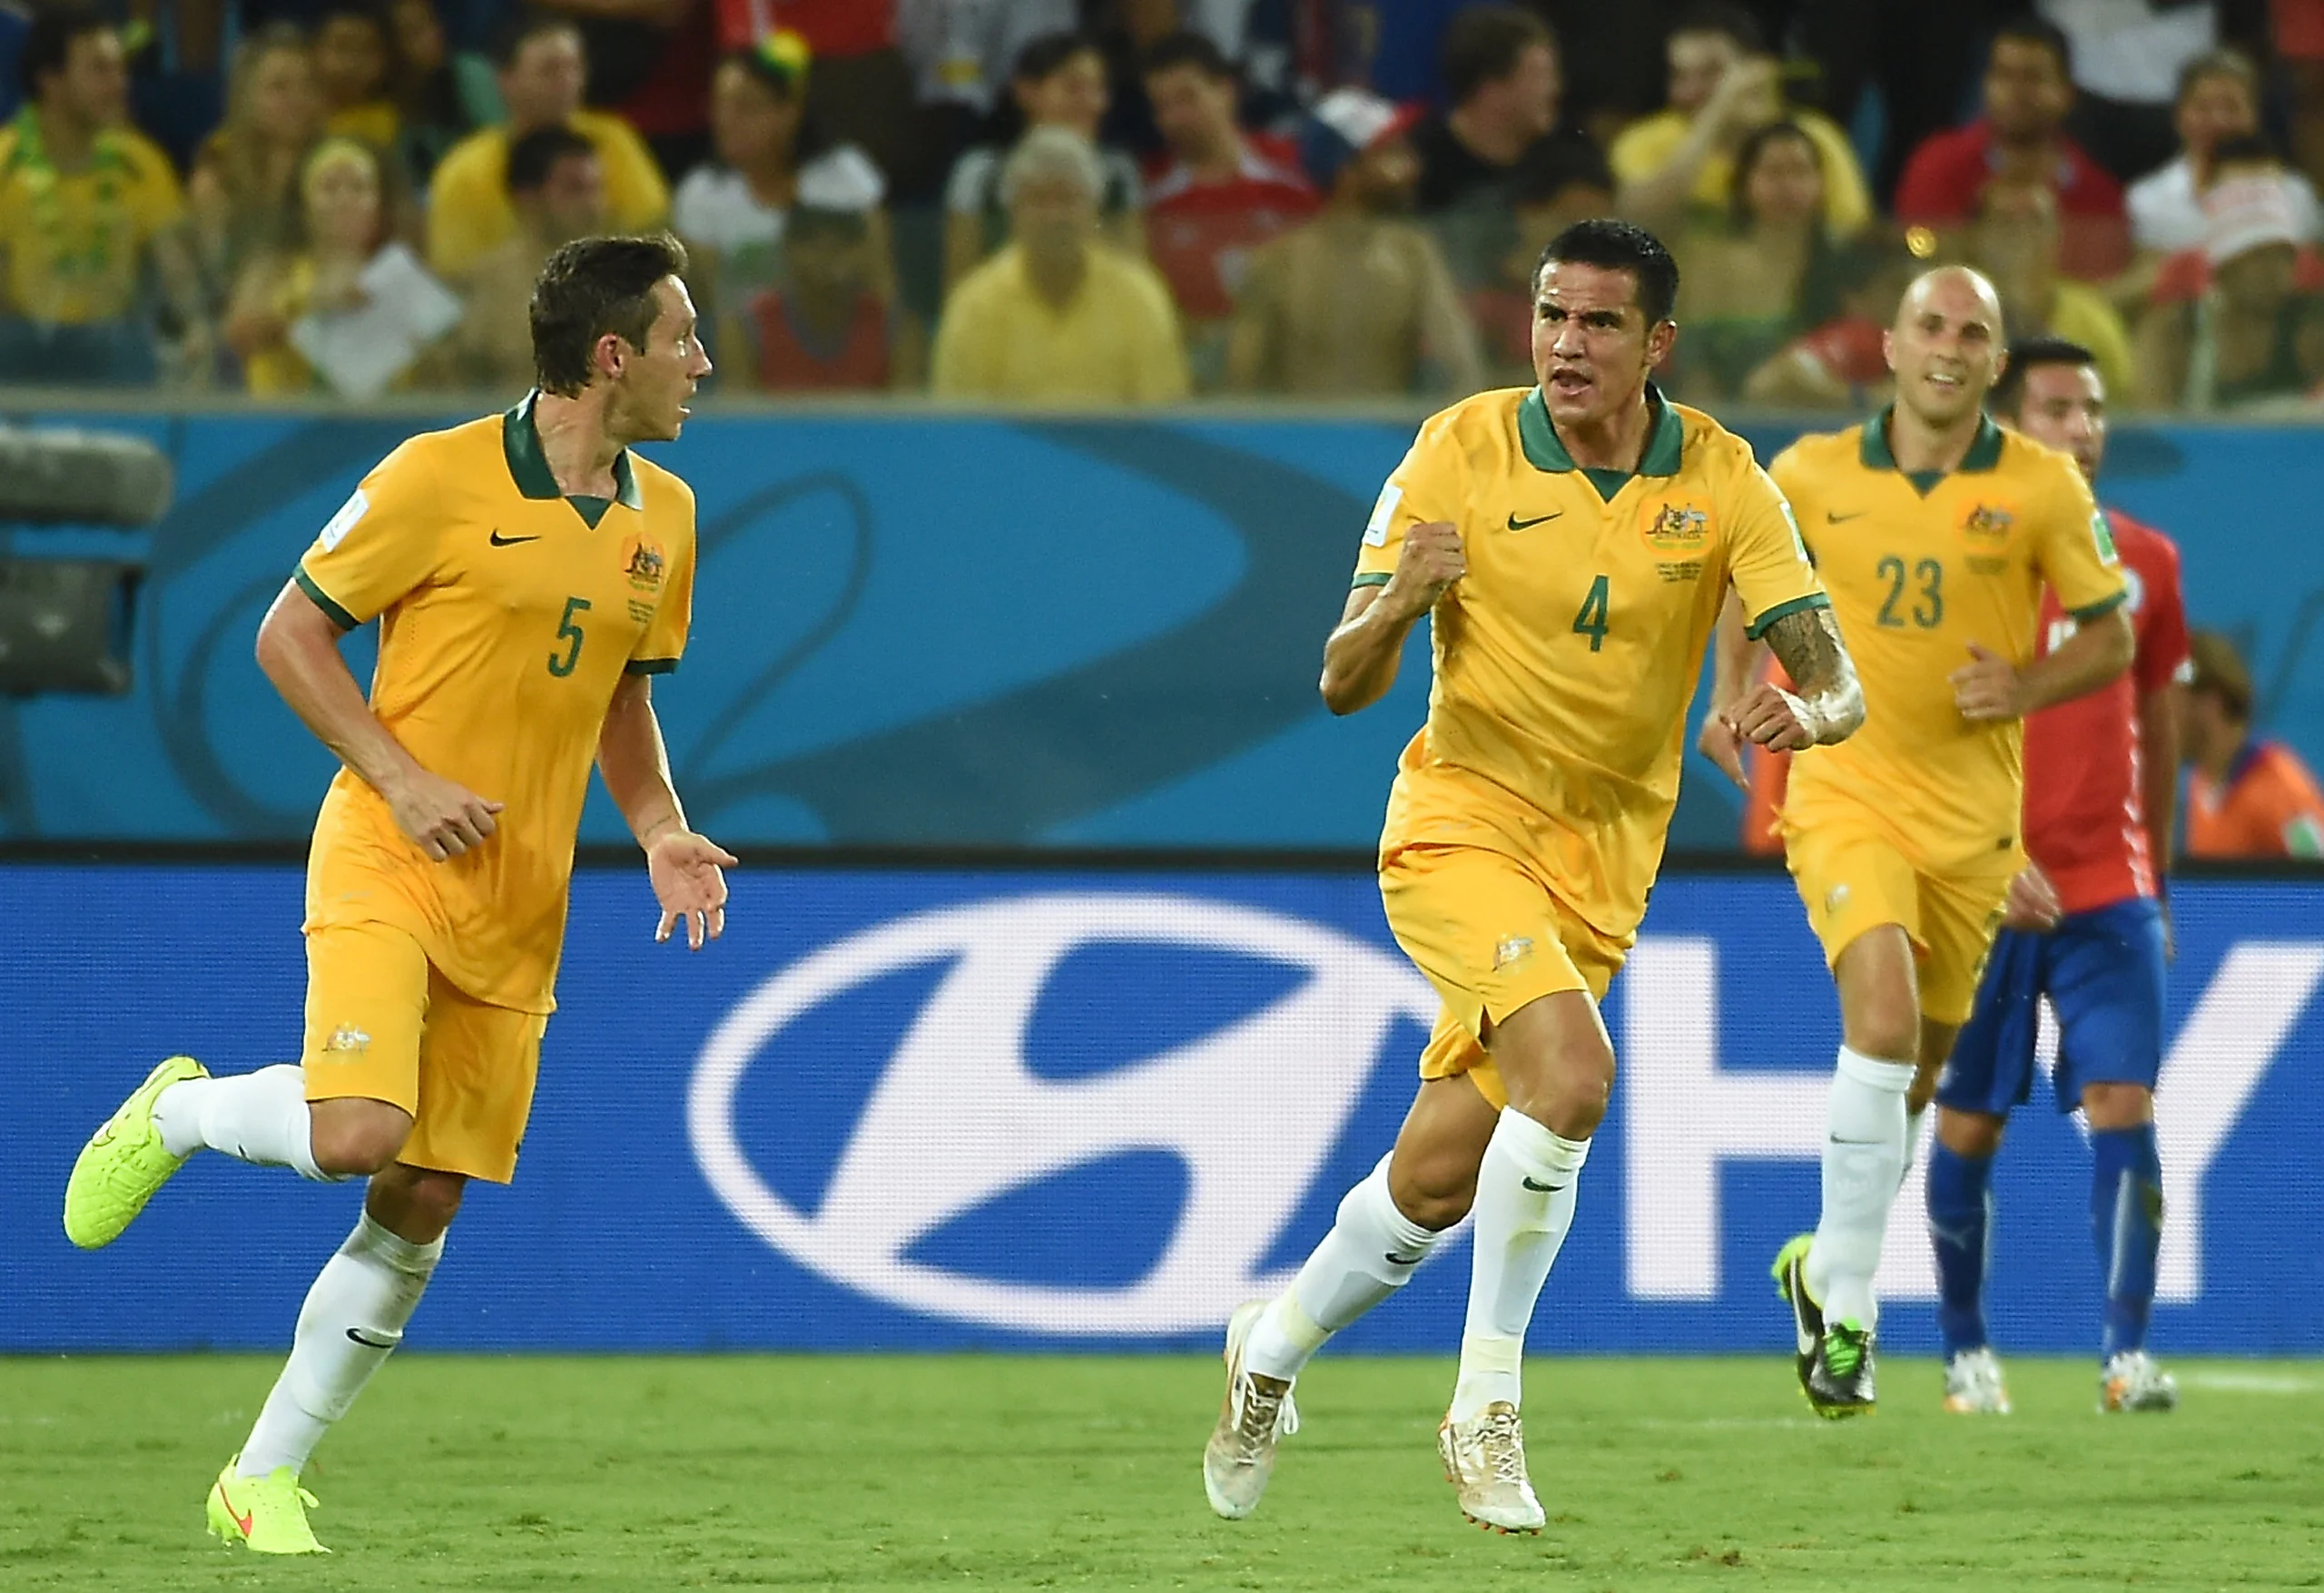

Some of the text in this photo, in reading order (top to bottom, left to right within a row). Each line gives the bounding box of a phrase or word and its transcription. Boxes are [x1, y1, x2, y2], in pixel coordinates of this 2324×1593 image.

[1573, 575, 1609, 652] 4
[1876, 557, 1942, 628] 23
[549, 597, 591, 677] 5
